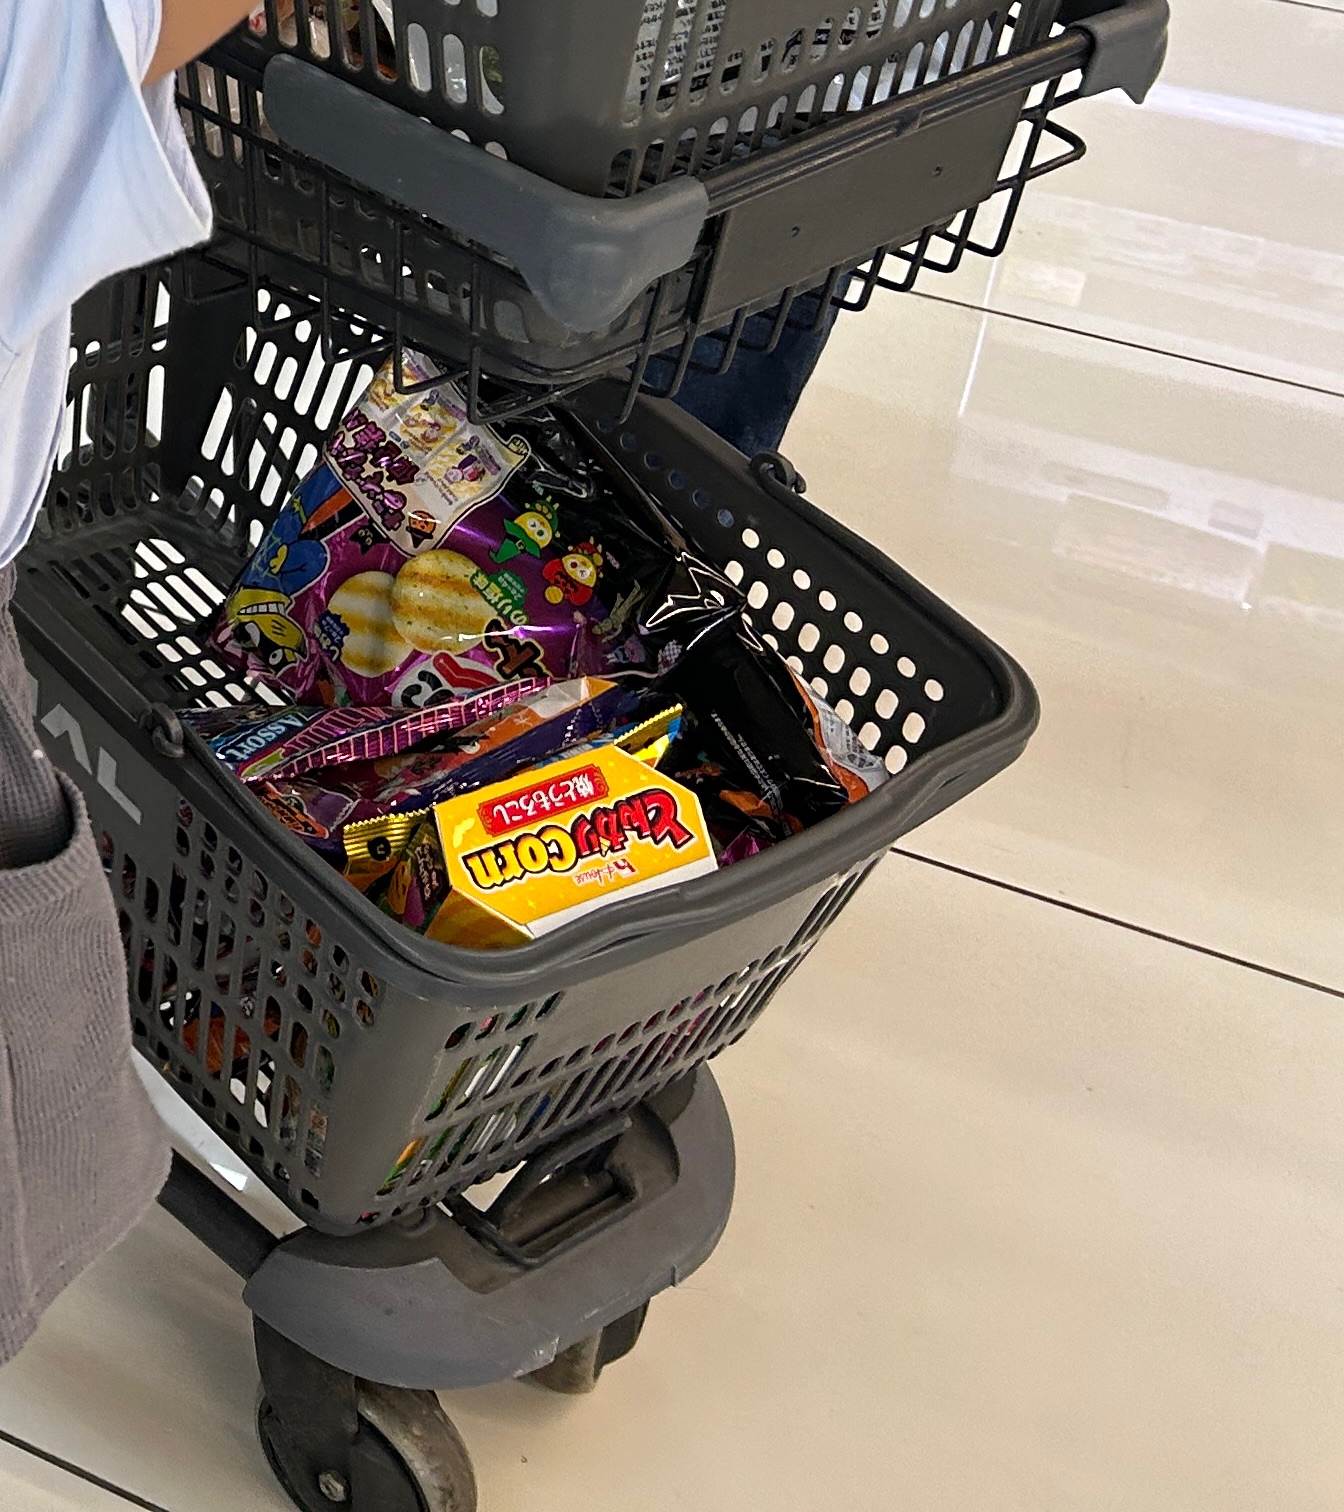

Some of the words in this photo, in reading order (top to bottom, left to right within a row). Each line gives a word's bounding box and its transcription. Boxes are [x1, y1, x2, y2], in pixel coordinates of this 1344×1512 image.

[492, 772, 596, 825] 焼とうもろこし
